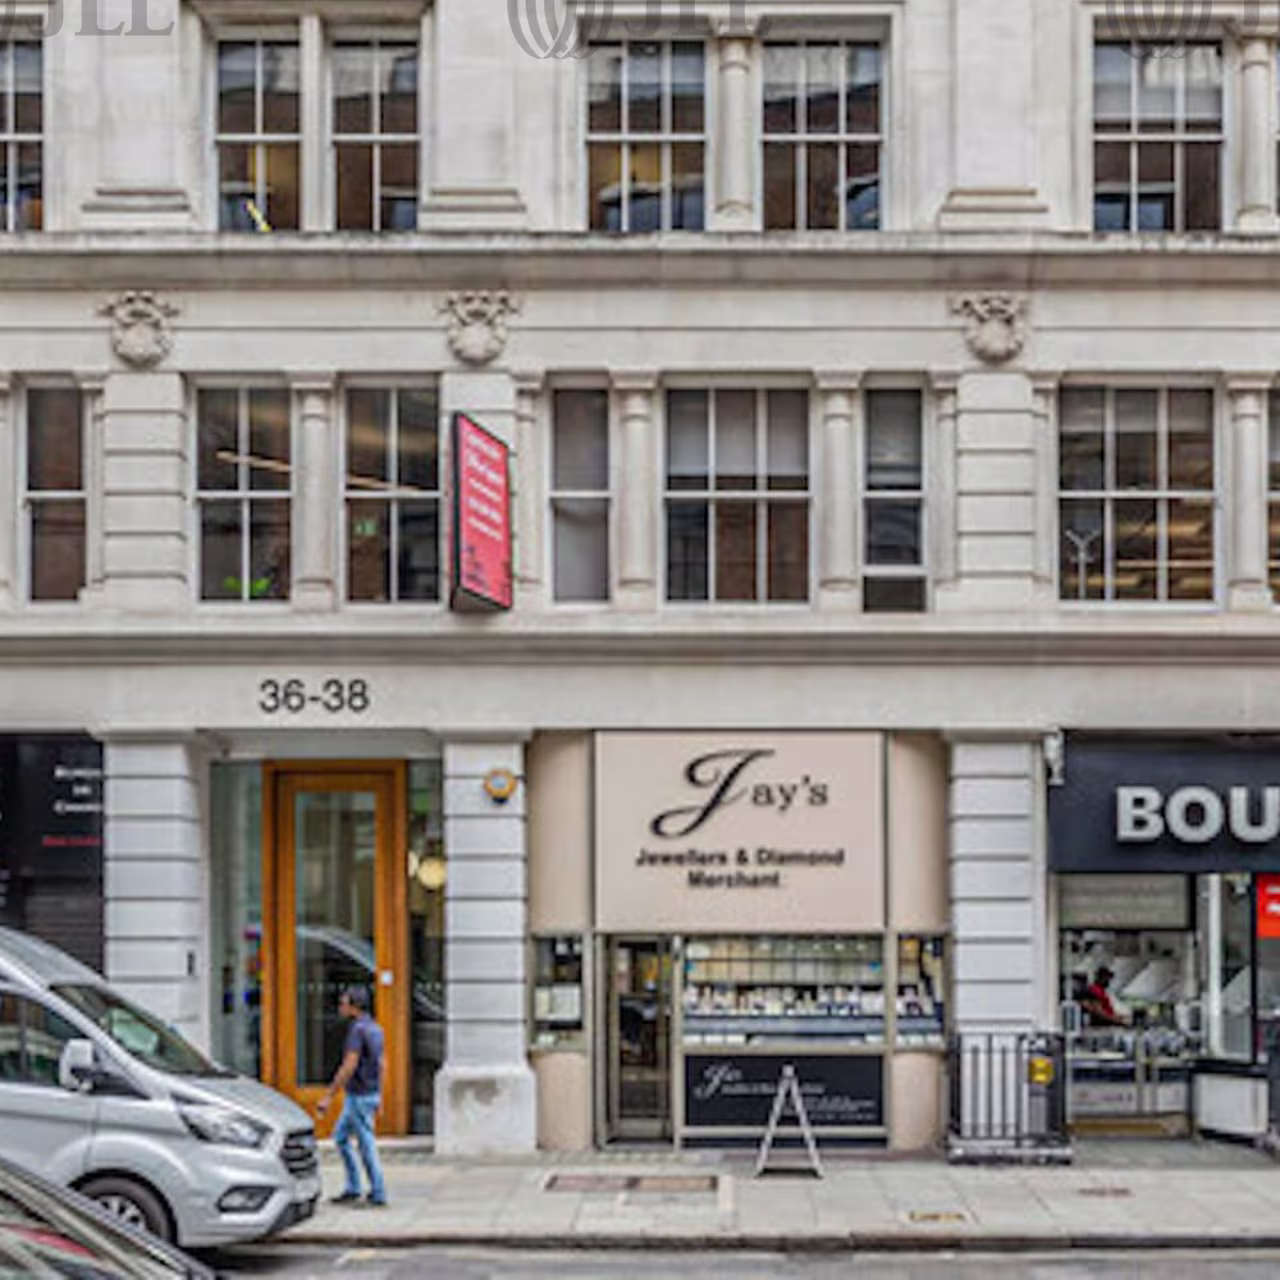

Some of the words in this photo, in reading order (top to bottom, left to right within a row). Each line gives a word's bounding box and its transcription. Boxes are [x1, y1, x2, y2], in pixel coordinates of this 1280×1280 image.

[260, 678, 369, 713] 36-38
[648, 749, 829, 839] Jay's
[635, 848, 728, 867] Jewellers
[736, 848, 748, 865] &
[756, 847, 846, 866] Diamond
[687, 870, 780, 889] Merchant
